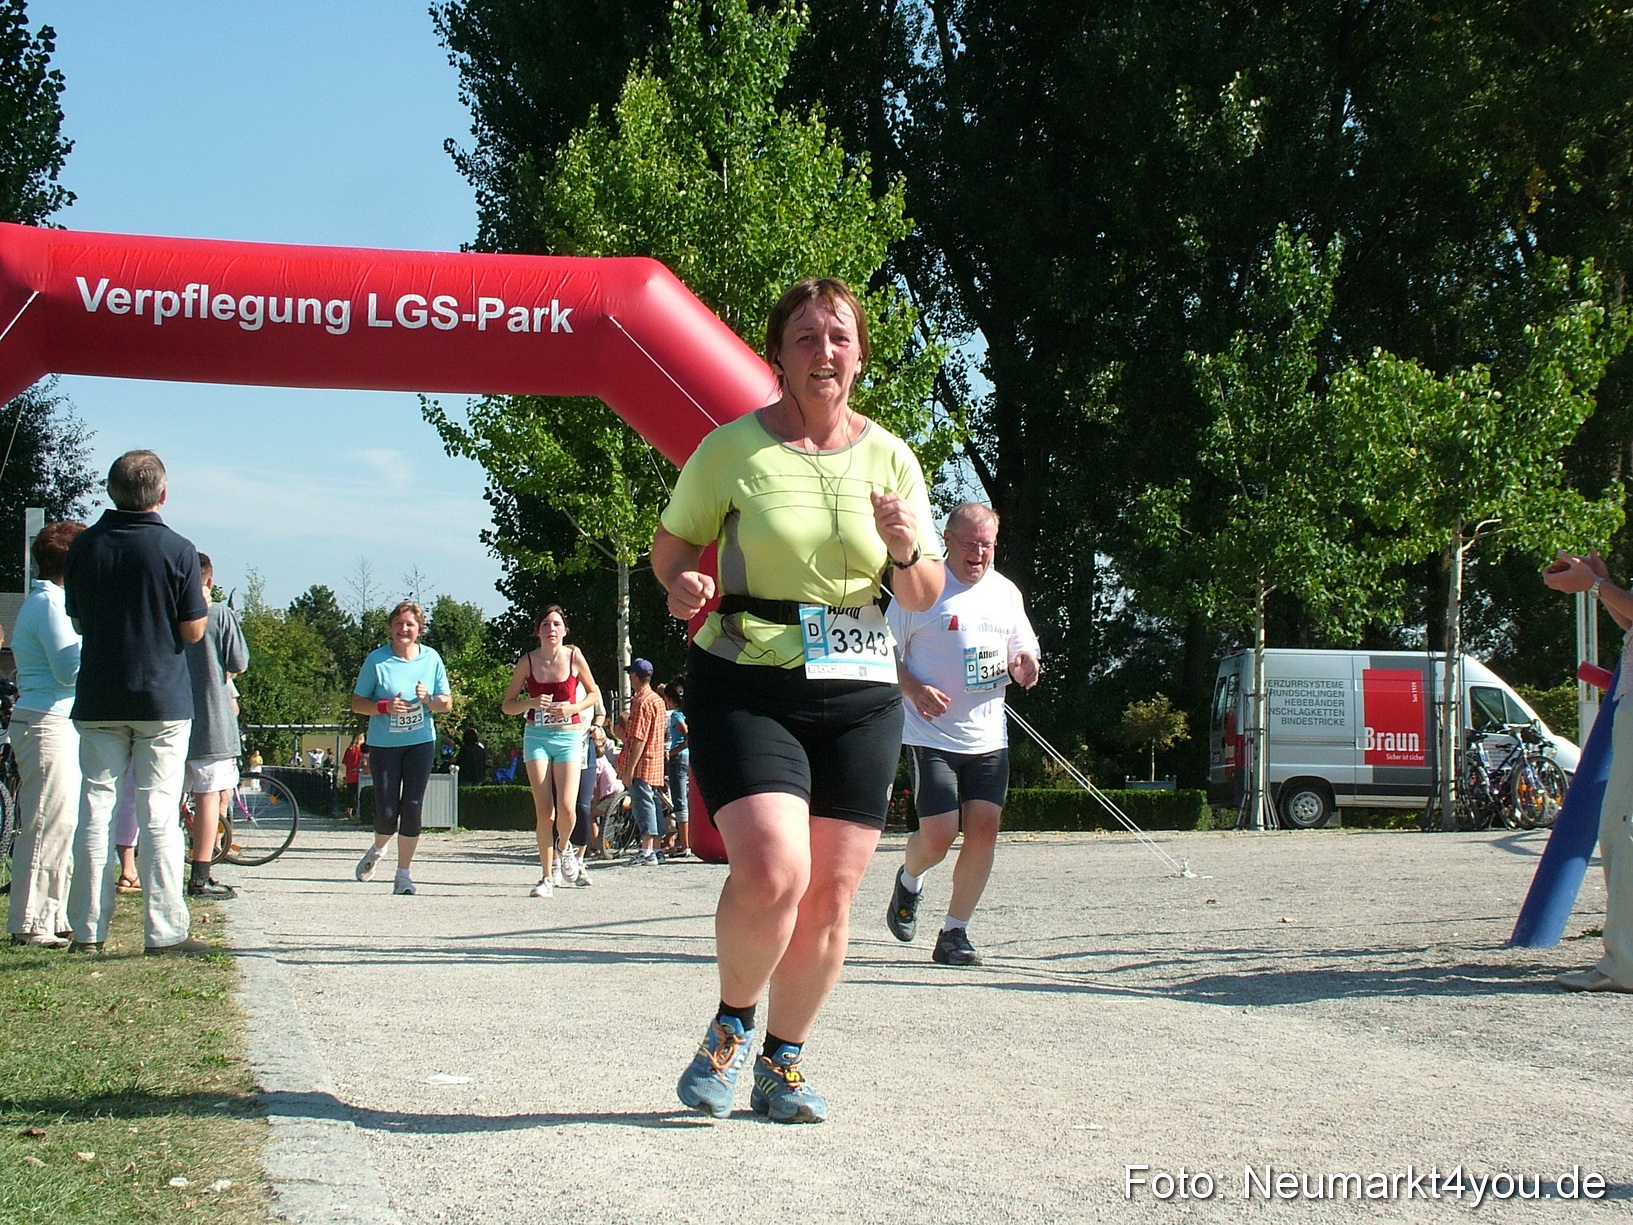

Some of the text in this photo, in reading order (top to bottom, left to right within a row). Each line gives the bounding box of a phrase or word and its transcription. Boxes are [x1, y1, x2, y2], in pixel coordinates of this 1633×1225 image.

[75, 276, 574, 335] Verpflegung LGS-Park
[808, 623, 819, 636] D
[831, 628, 888, 656] 3343
[979, 650, 999, 660] Alfons
[968, 664, 975, 672] D
[980, 660, 1006, 679] 3182
[1268, 707, 1345, 716] NSCHLAGKETTEN
[400, 713, 422, 725] 3323
[1281, 717, 1345, 726] BINDESTRICKE
[1364, 726, 1419, 751] Braun
